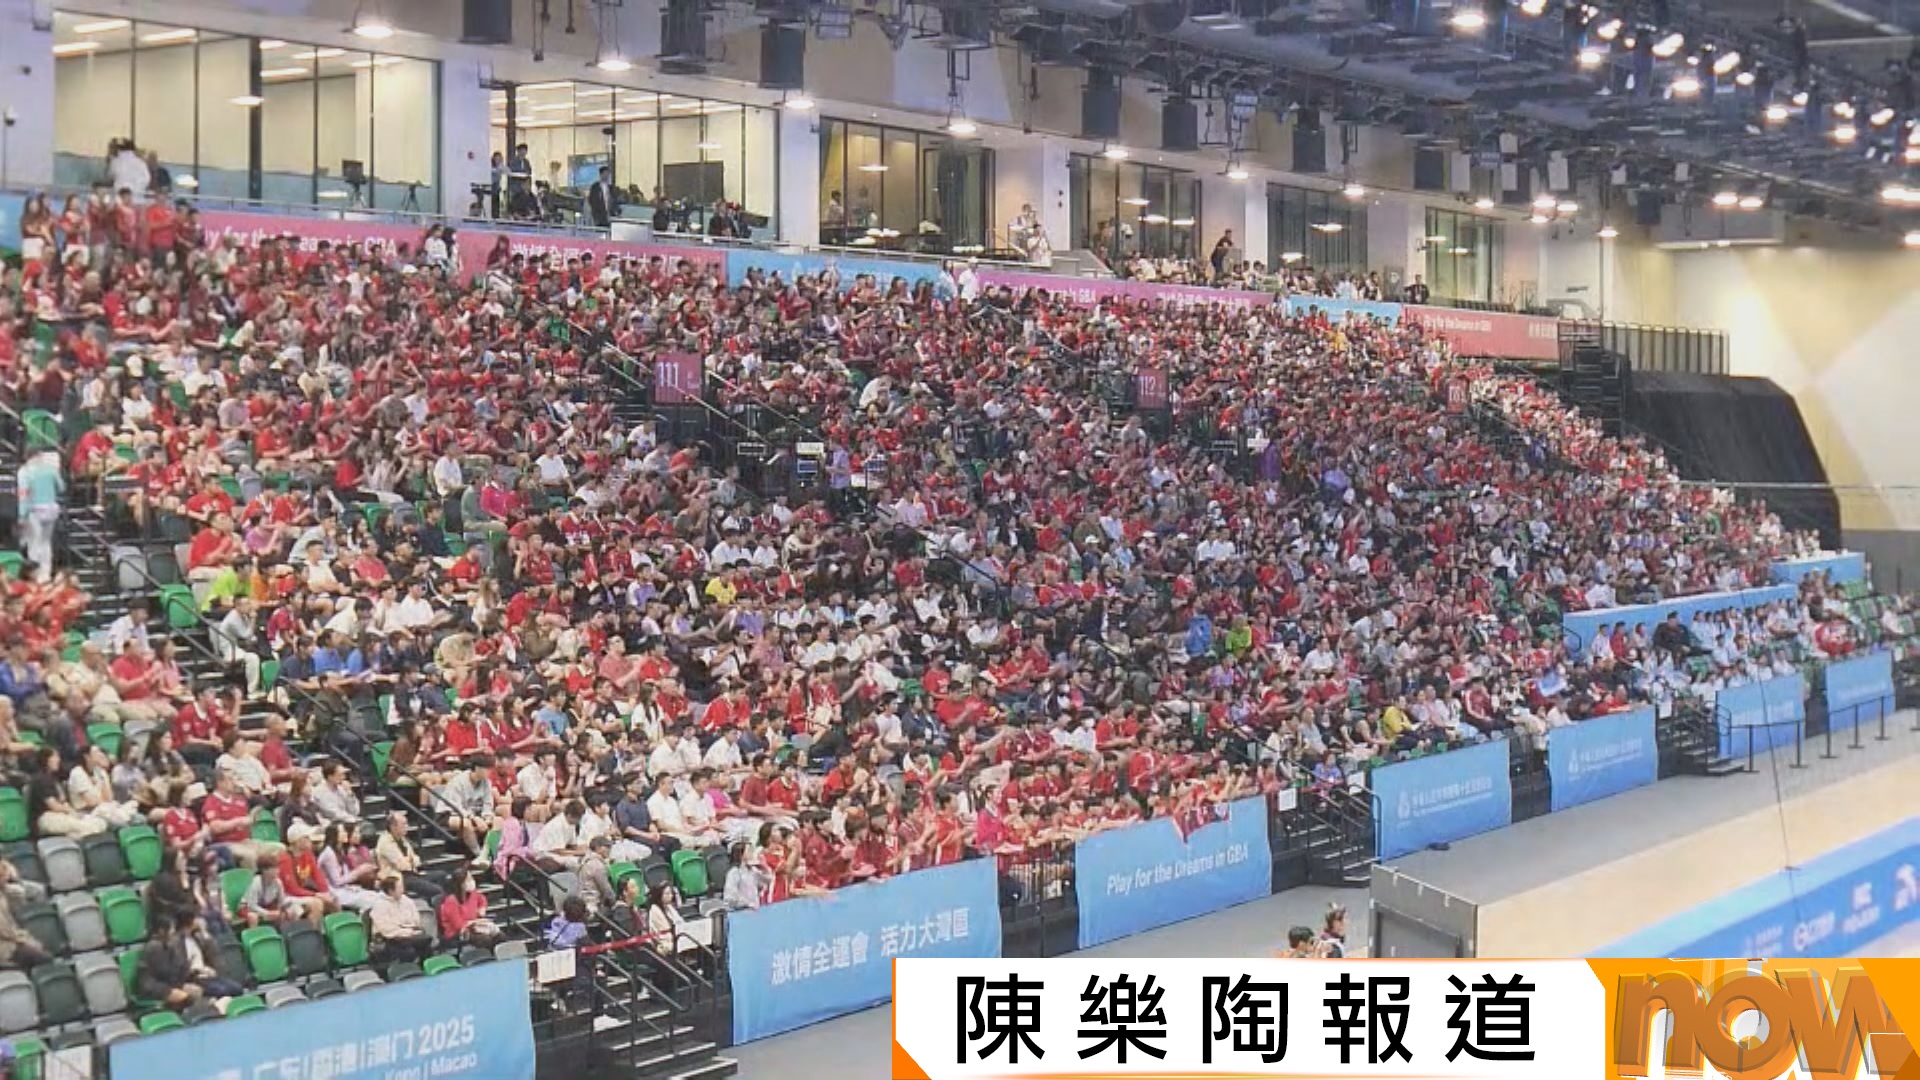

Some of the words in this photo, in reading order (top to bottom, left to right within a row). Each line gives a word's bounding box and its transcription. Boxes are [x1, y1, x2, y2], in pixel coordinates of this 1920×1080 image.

[658, 362, 678, 388] 111
[1107, 874, 1132, 896] Play
[1135, 867, 1151, 889] for
[1154, 863, 1172, 884] the
[1175, 854, 1214, 879] Dreams
[1215, 851, 1225, 867] in
[1227, 842, 1249, 864] GBA
[771, 931, 869, 985] 激情全運會
[880, 907, 970, 957] 活力大灣區
[418, 1014, 475, 1056] 2025
[431, 1052, 477, 1076] Macao
